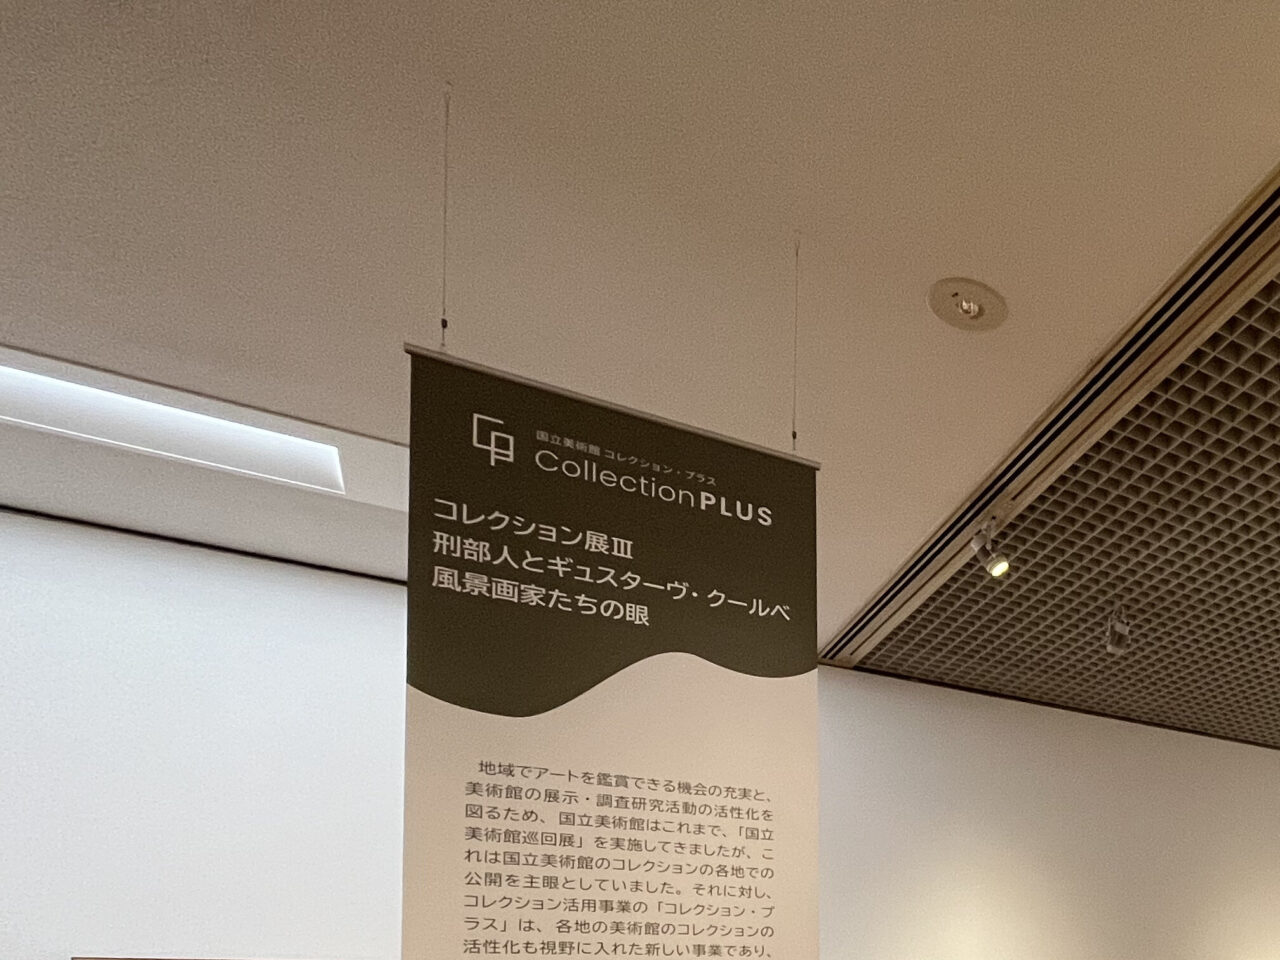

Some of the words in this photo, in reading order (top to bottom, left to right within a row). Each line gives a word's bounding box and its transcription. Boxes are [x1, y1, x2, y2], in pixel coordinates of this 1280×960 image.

[536, 429, 601, 456] 国立美術館
[604, 448, 717, 486] コレクション・プラス
[433, 531, 791, 620] 刑部人とギュスターヴ・クールベ
[432, 566, 650, 626] 風景画家たちの眼
[478, 760, 772, 803] 地域でアートを鑑賞できる機会の充実と、
[465, 782, 774, 822] 美術館の展示・調査研究活動の活性化を
[465, 804, 774, 841] 図るため、国立美術館はこれまで、「国立
[465, 827, 774, 860] 美術館巡回展」を実施してきましたが、こ
[464, 849, 775, 879] れは国立美術館のコレクションの各地での
[464, 872, 772, 899] 公開を主眼としていました。それに対し、
[464, 917, 775, 938] ラス」は、各地の美術館のコレクションの
[463, 939, 772, 958] 活性化も視野に入れた新しい事業であり、
